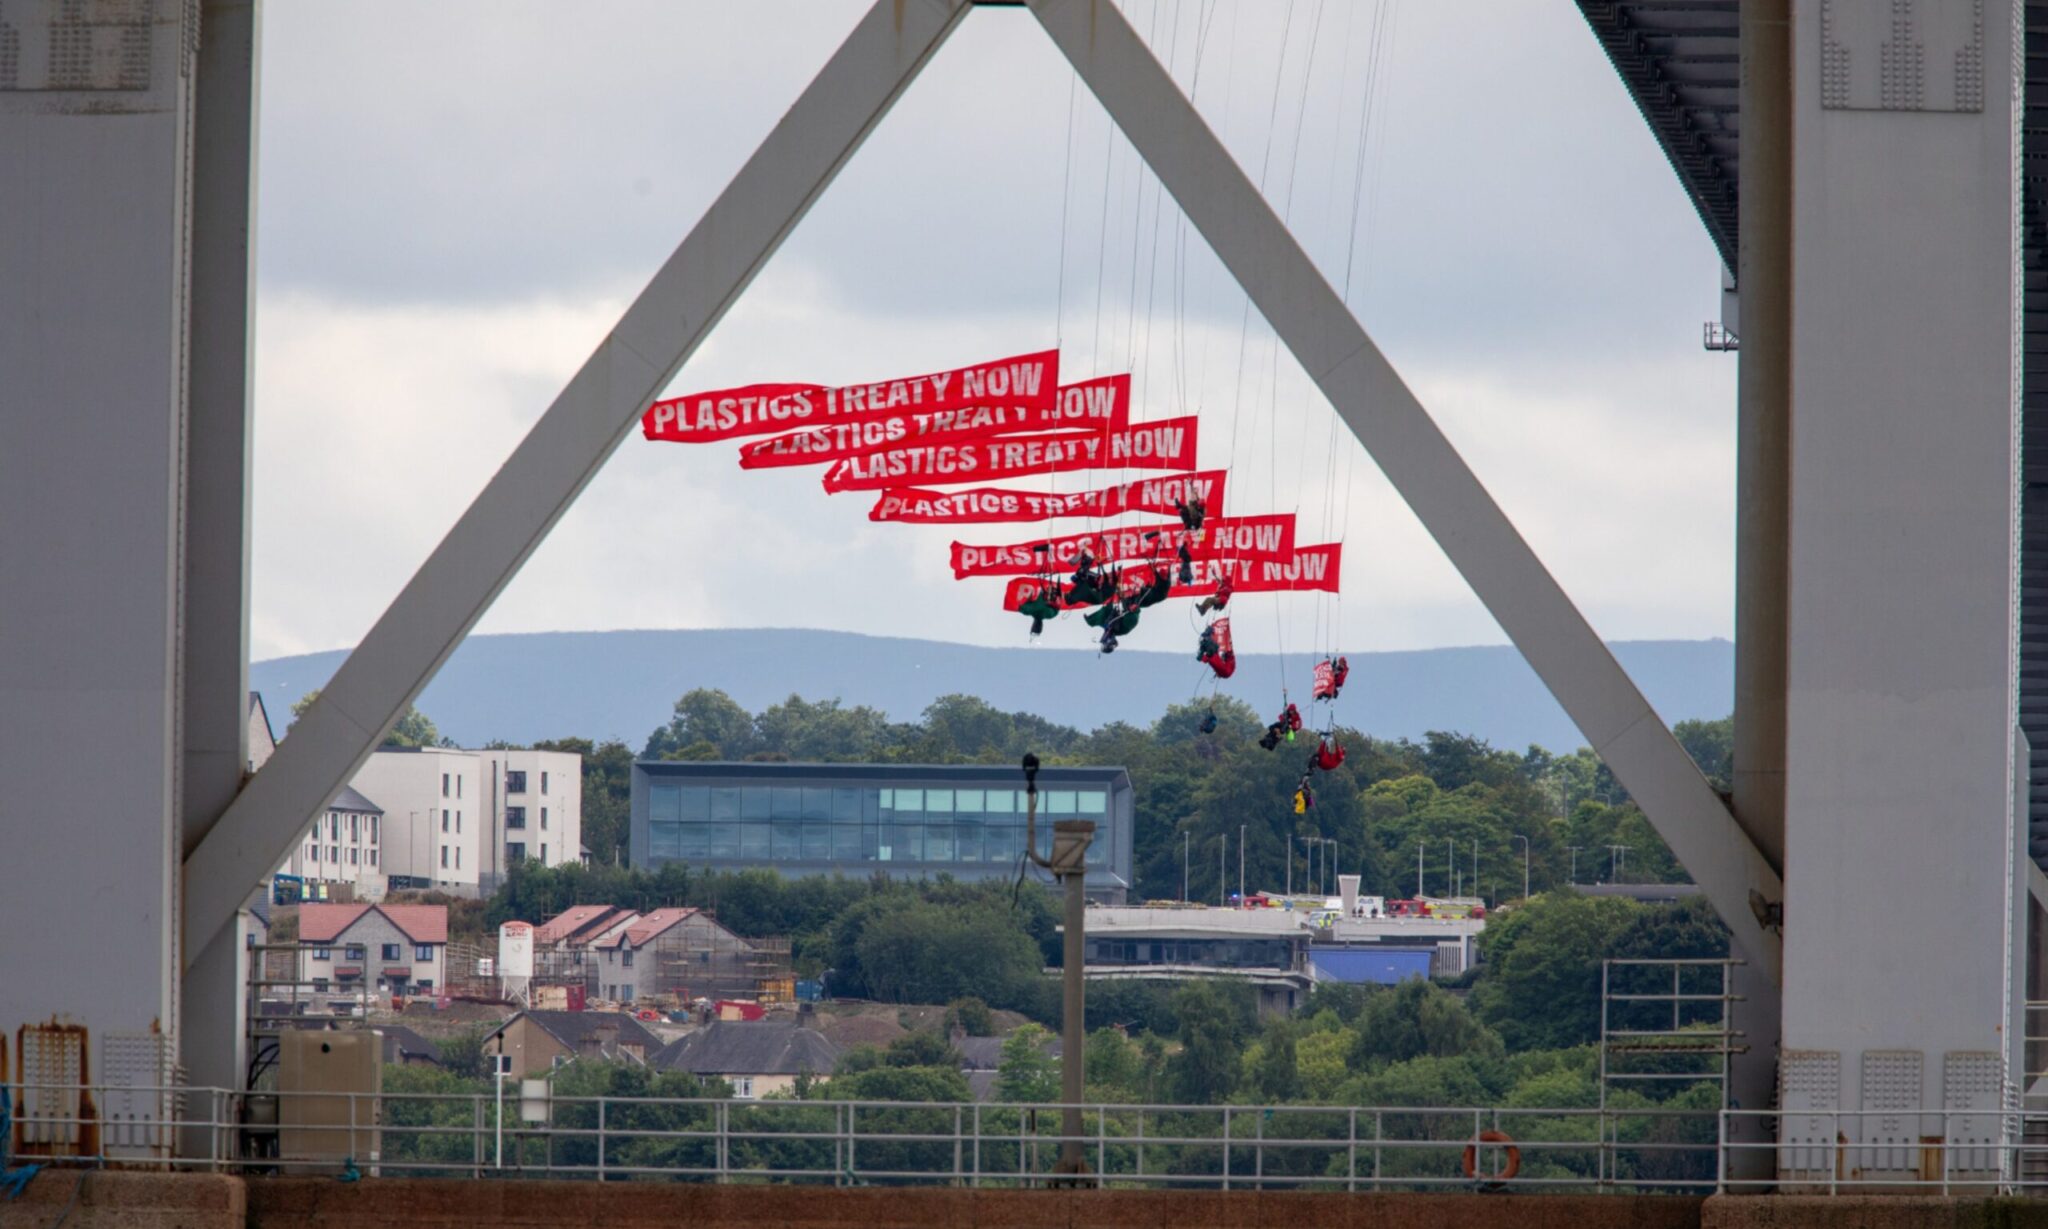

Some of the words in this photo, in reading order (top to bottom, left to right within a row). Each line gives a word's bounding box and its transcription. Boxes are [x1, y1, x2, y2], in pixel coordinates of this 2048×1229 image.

[654, 390, 813, 433] PLASTICS
[823, 372, 951, 415] TREATY
[962, 362, 1044, 398] NOW
[987, 437, 1100, 469] TREATY
[1112, 427, 1184, 459] NOW
[879, 494, 1020, 519] PLASTICS
[1142, 479, 1213, 508] NOW
[1214, 525, 1282, 552] NOW
[1263, 552, 1329, 581] NOW
